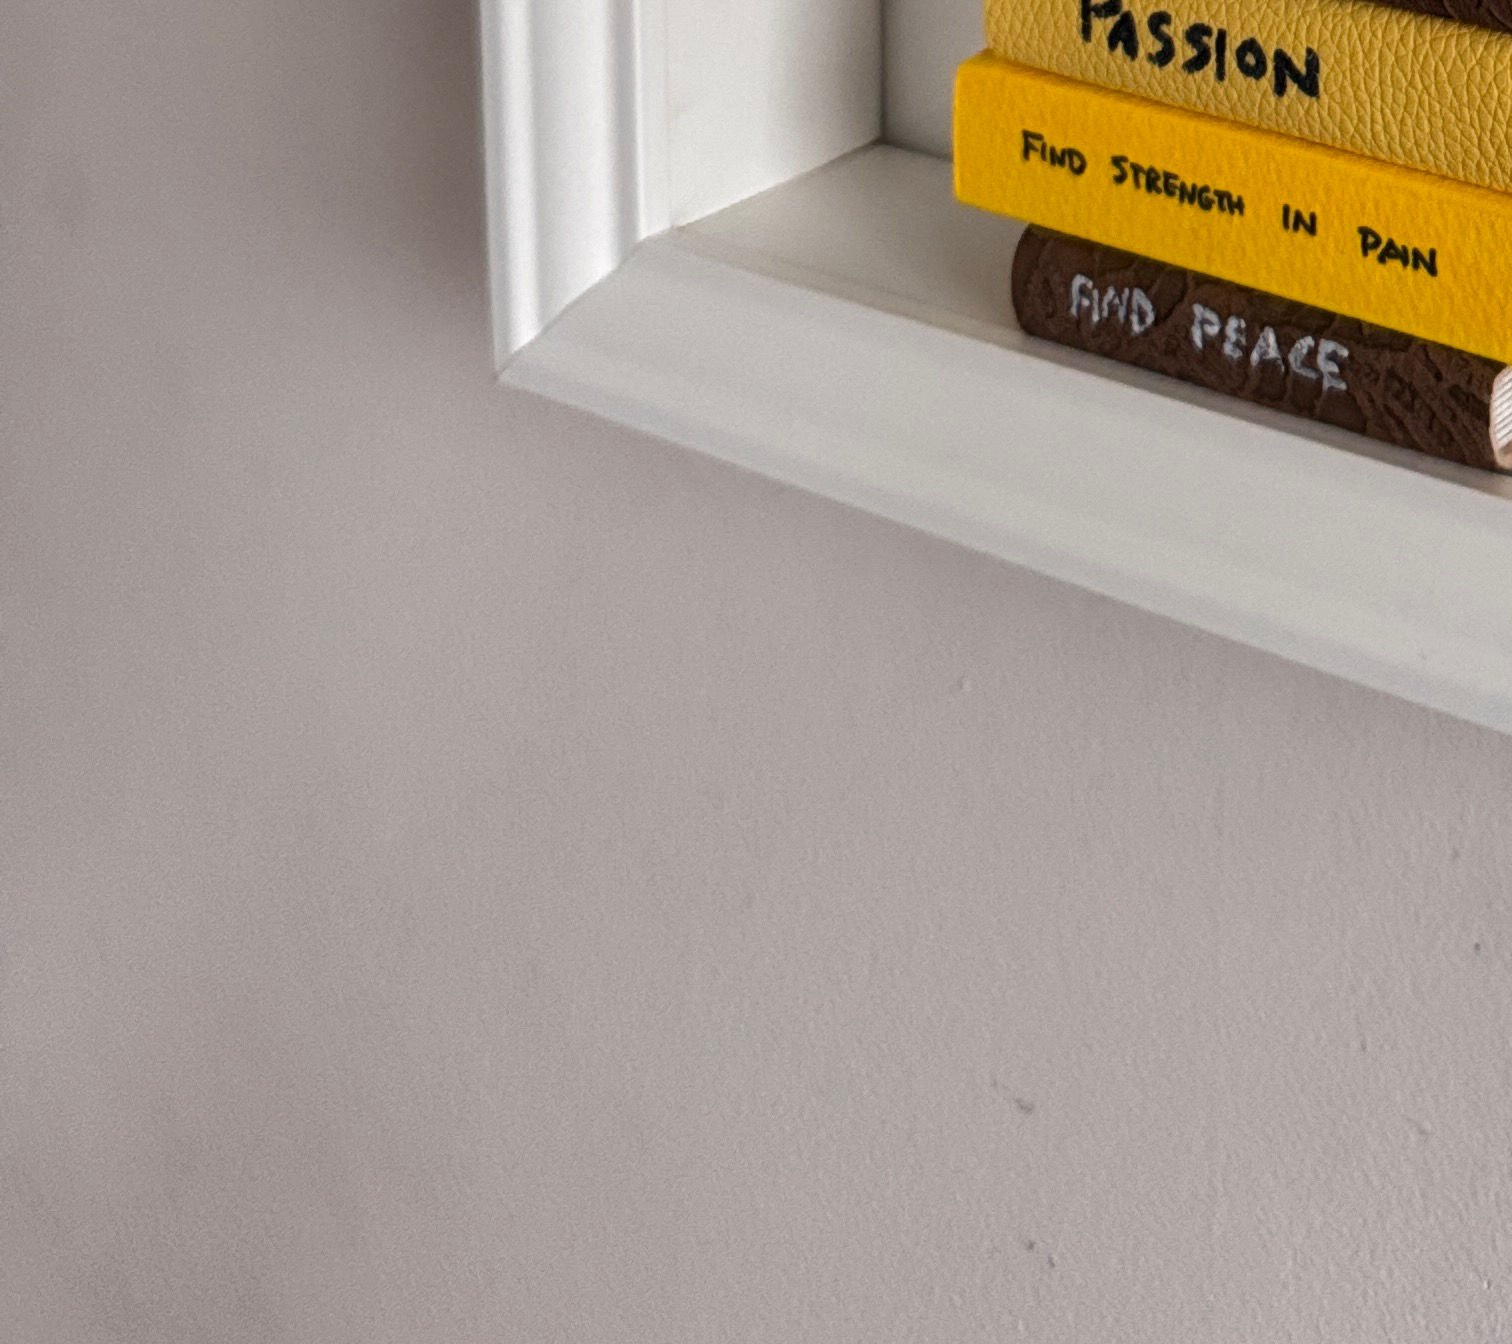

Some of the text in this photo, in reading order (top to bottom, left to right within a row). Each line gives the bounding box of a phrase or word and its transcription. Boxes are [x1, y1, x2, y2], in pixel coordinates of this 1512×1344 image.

[1021, 129, 1438, 277] FIND STRENGTH IN PAIN
[1192, 303, 1349, 391] PEACE
